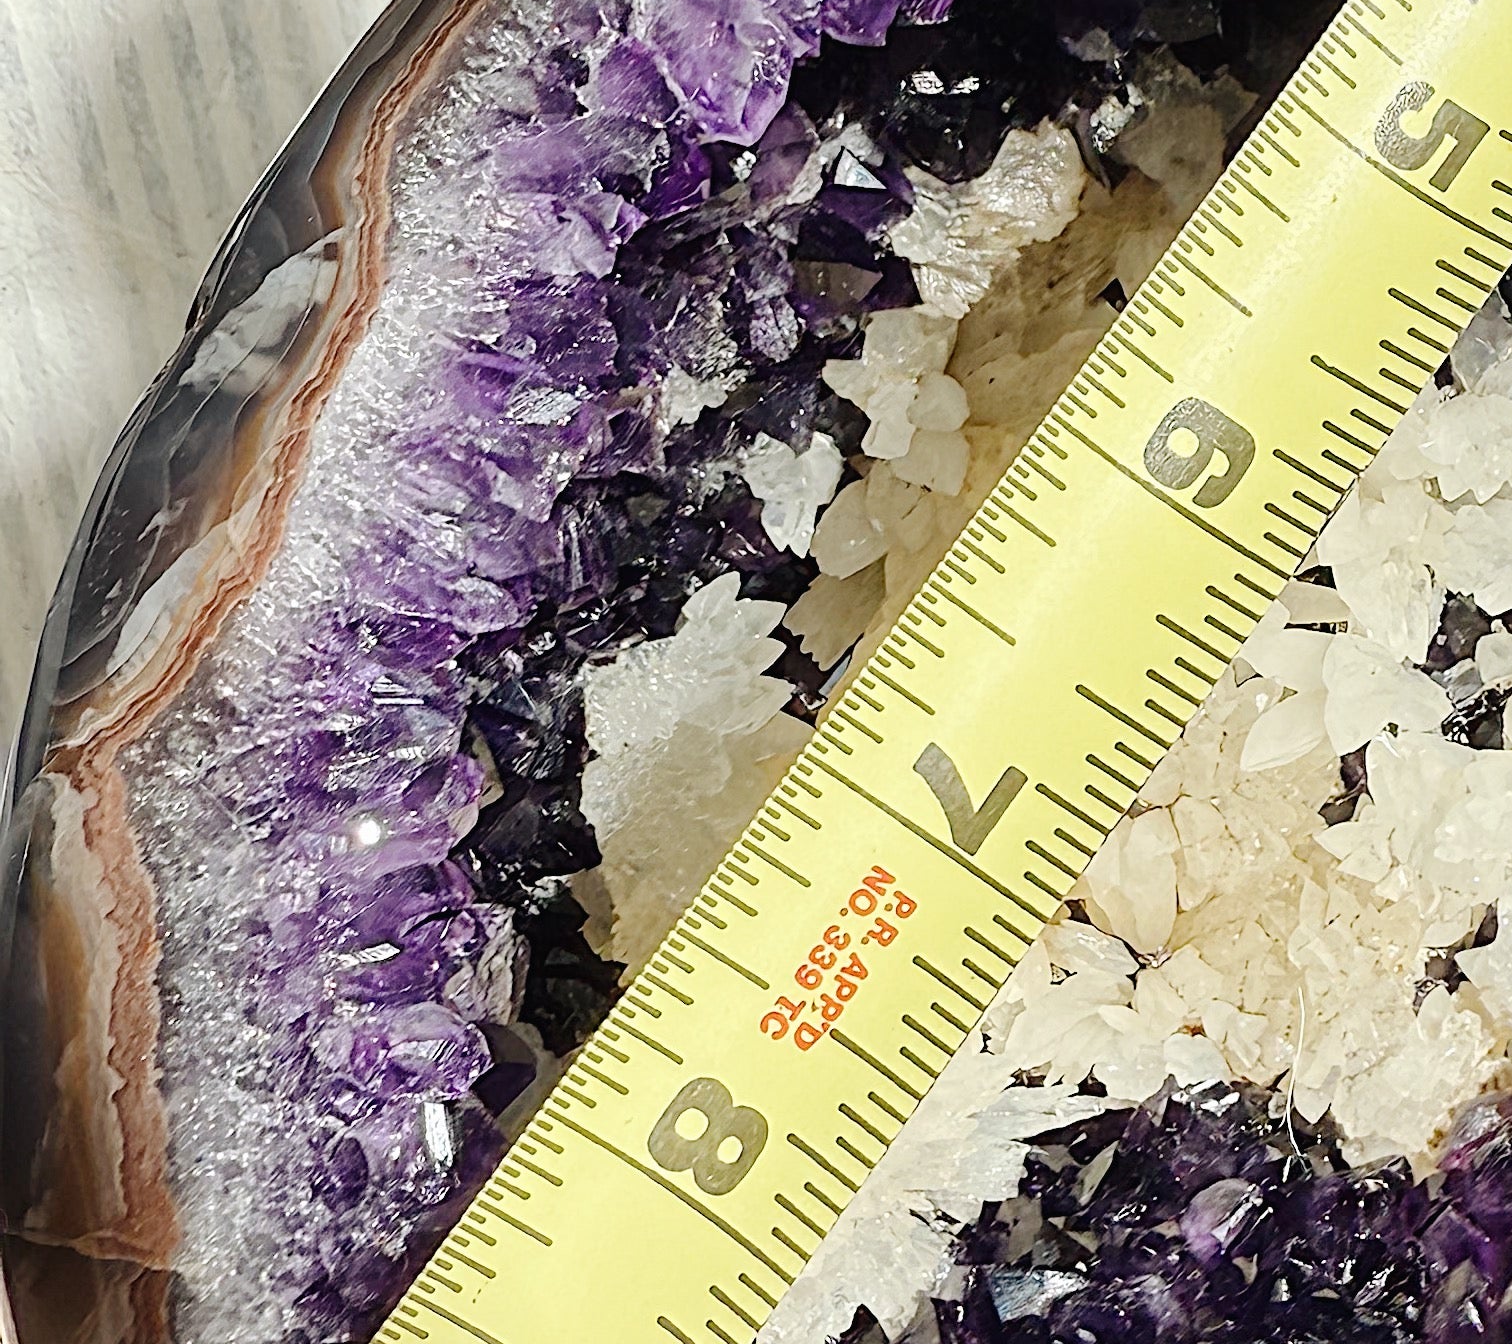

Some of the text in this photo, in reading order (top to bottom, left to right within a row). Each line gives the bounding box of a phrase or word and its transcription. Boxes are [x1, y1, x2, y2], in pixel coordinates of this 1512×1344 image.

[1373, 80, 1491, 192] 5
[1143, 396, 1256, 509] 6
[912, 741, 1028, 856] 7
[759, 864, 897, 1041] NO. 339 TC
[793, 952, 869, 1052] APP'D
[646, 1076, 769, 1196] 8
